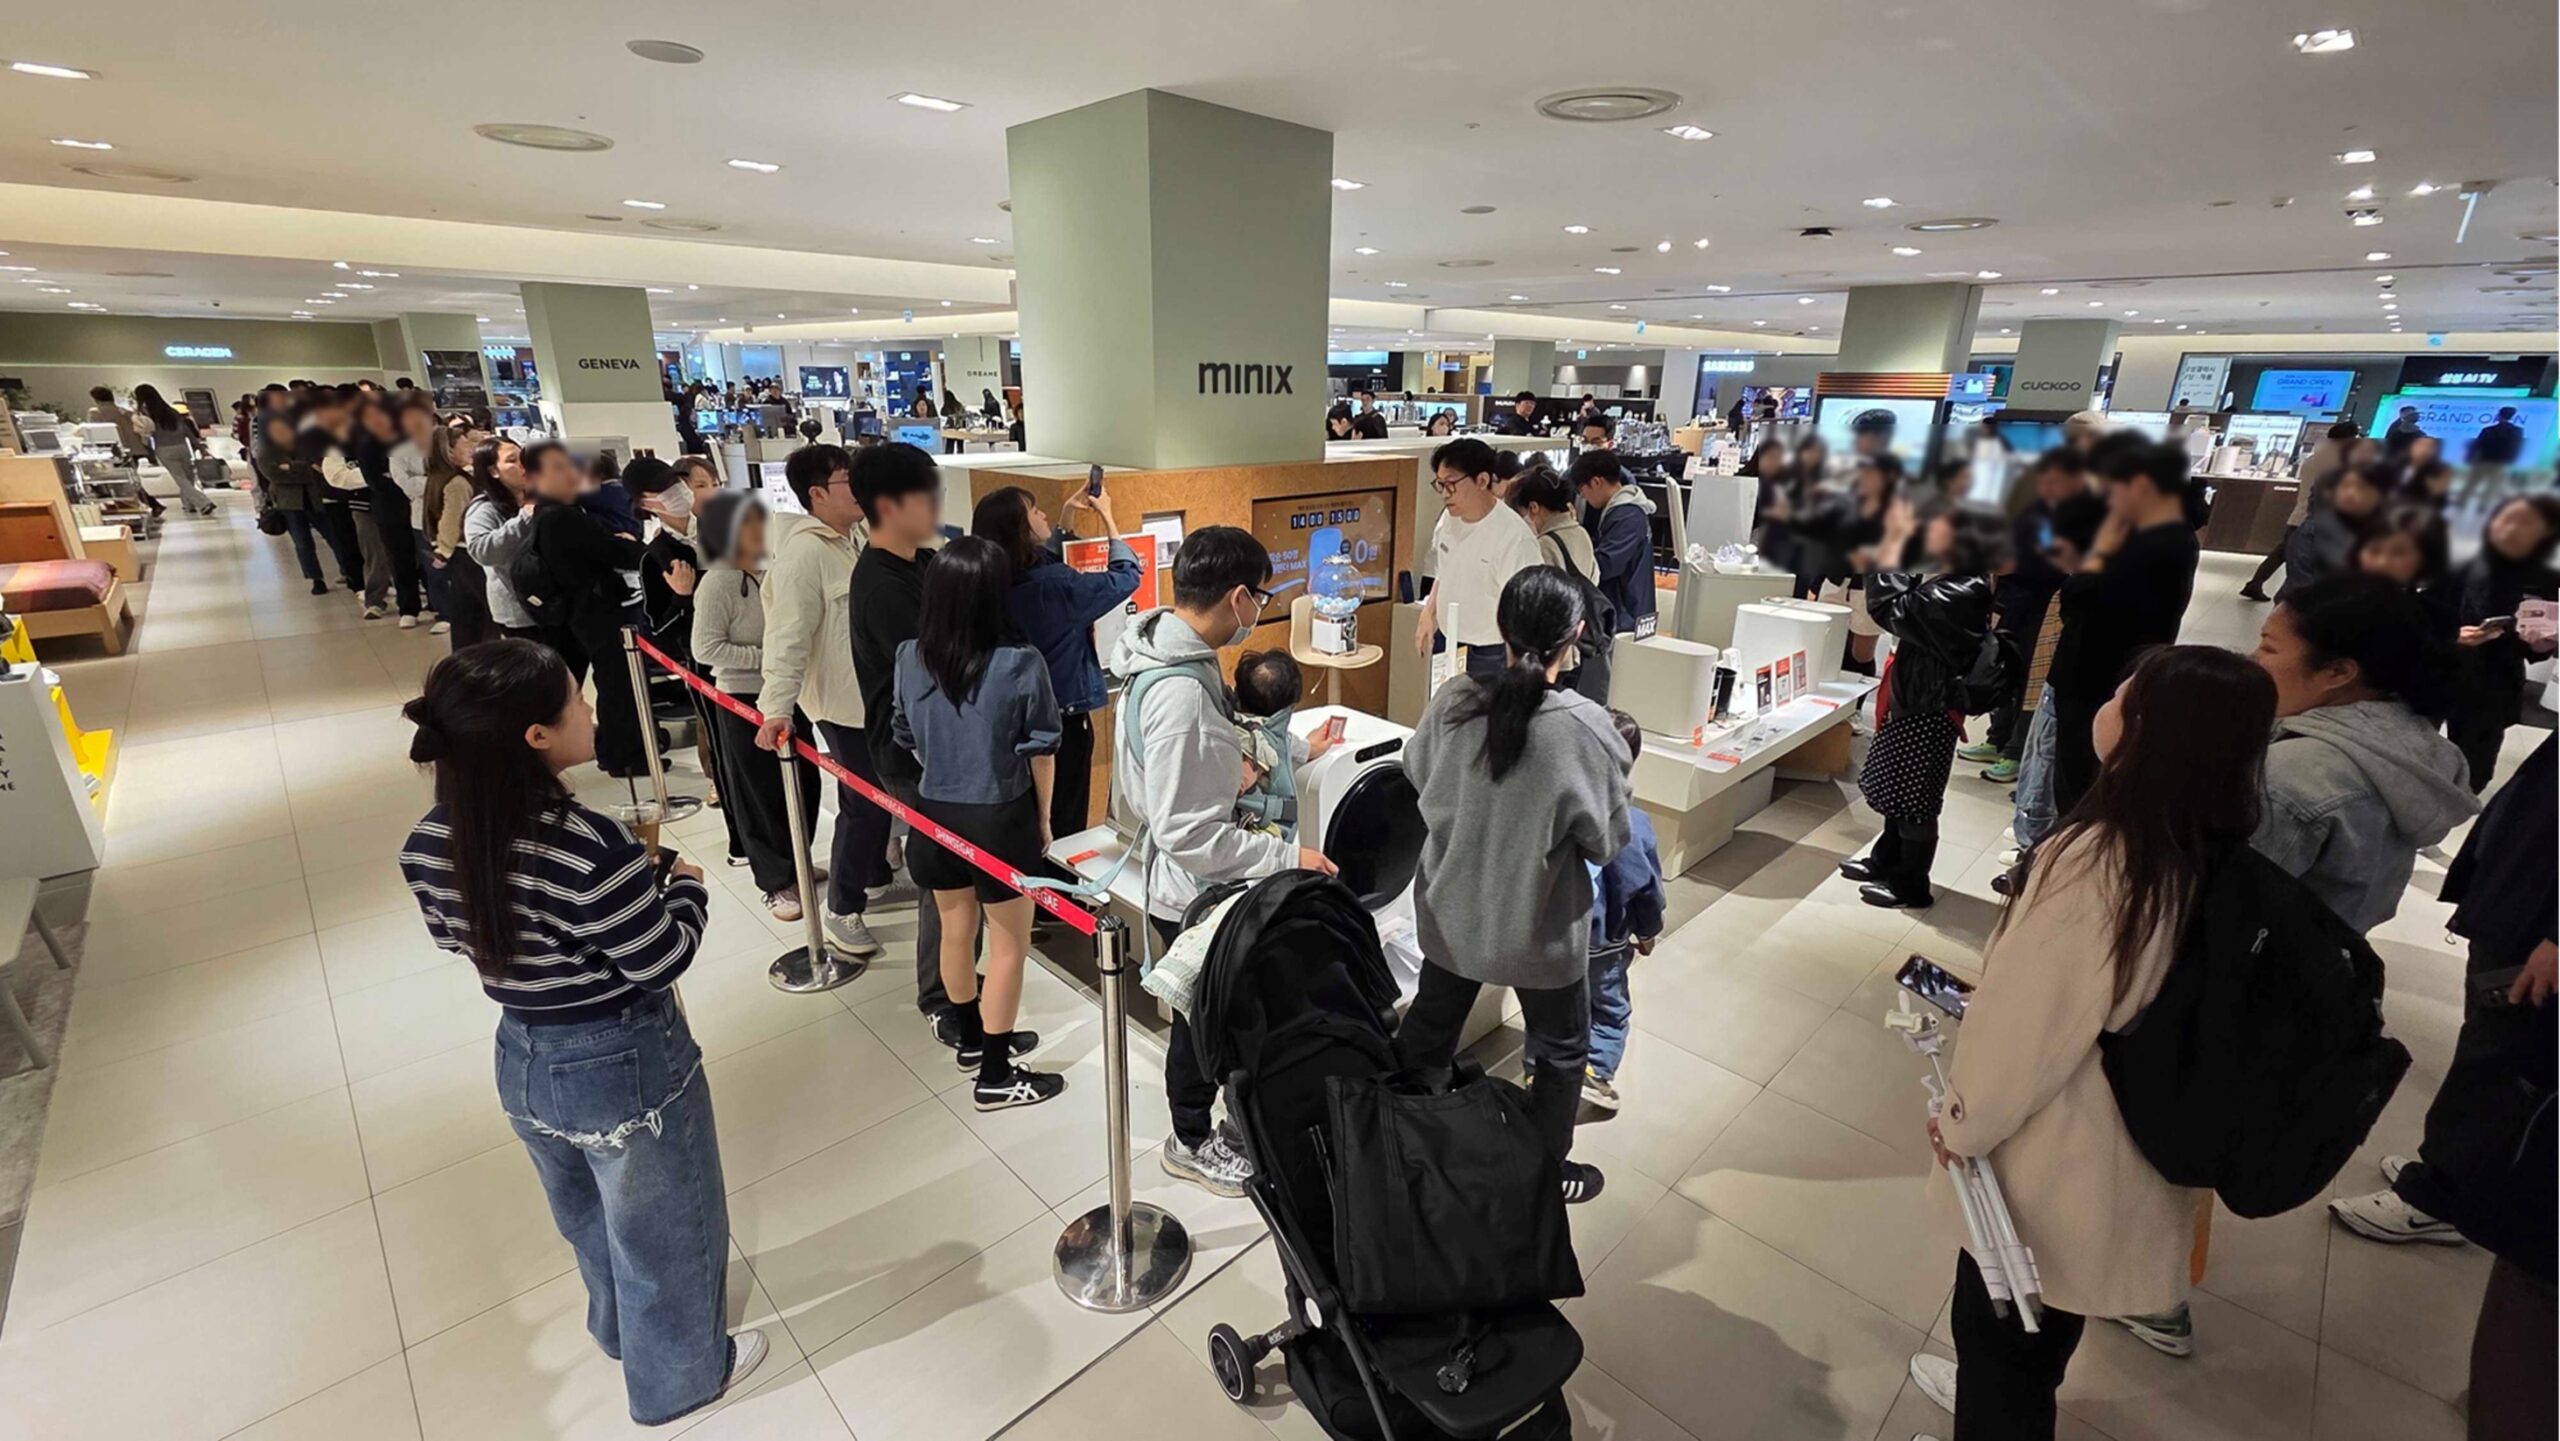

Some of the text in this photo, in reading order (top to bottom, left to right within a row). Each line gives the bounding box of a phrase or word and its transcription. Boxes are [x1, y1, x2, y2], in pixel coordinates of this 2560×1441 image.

[578, 358, 641, 370] GENEVA
[1198, 362, 1294, 395] minix
[2276, 378, 2334, 386] GRAND OPEN
[2478, 373, 2498, 384] TV
[2020, 380, 2082, 392] CUCKOO
[2478, 412, 2529, 425] ON
[1290, 560, 1307, 571] MAX
[1635, 620, 1657, 638] MAX
